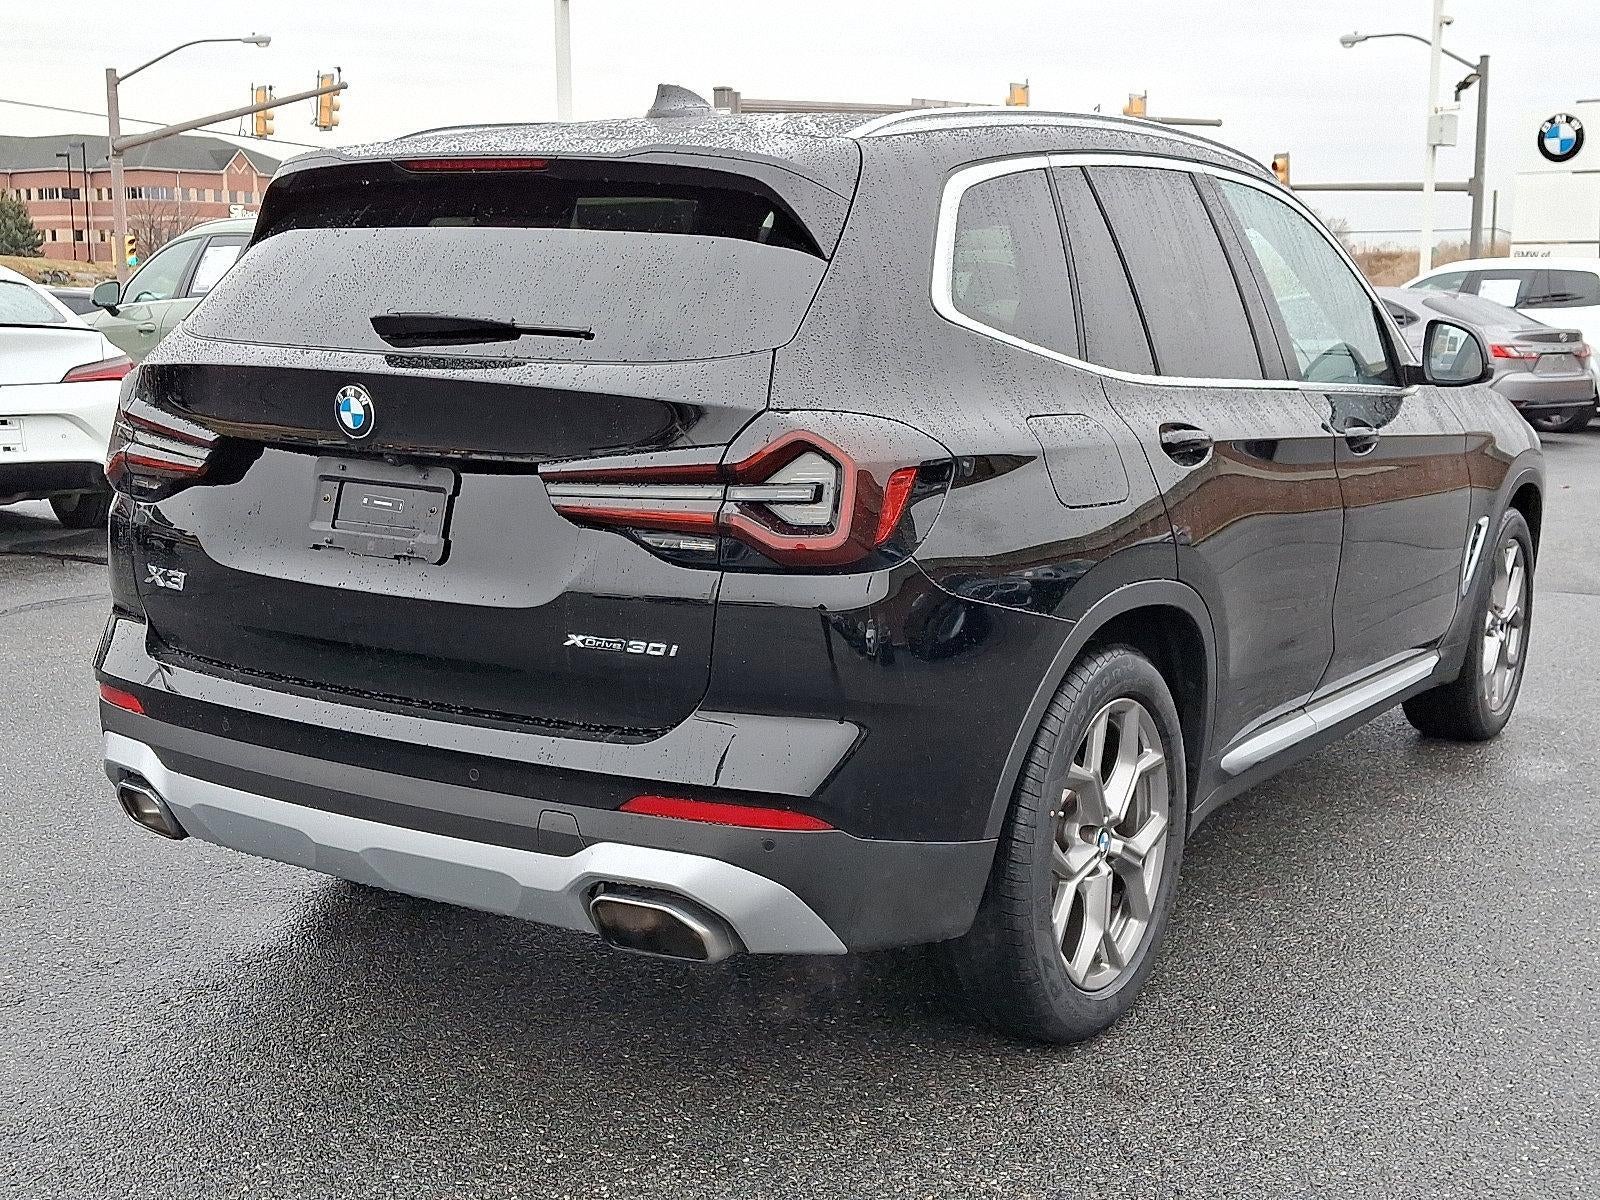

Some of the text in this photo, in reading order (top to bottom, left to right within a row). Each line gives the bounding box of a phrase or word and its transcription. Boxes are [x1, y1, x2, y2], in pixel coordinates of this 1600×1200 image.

[1541, 113, 1581, 133] BMW
[337, 387, 370, 406] BMW
[143, 562, 188, 591] X3
[626, 640, 679, 657] 30i
